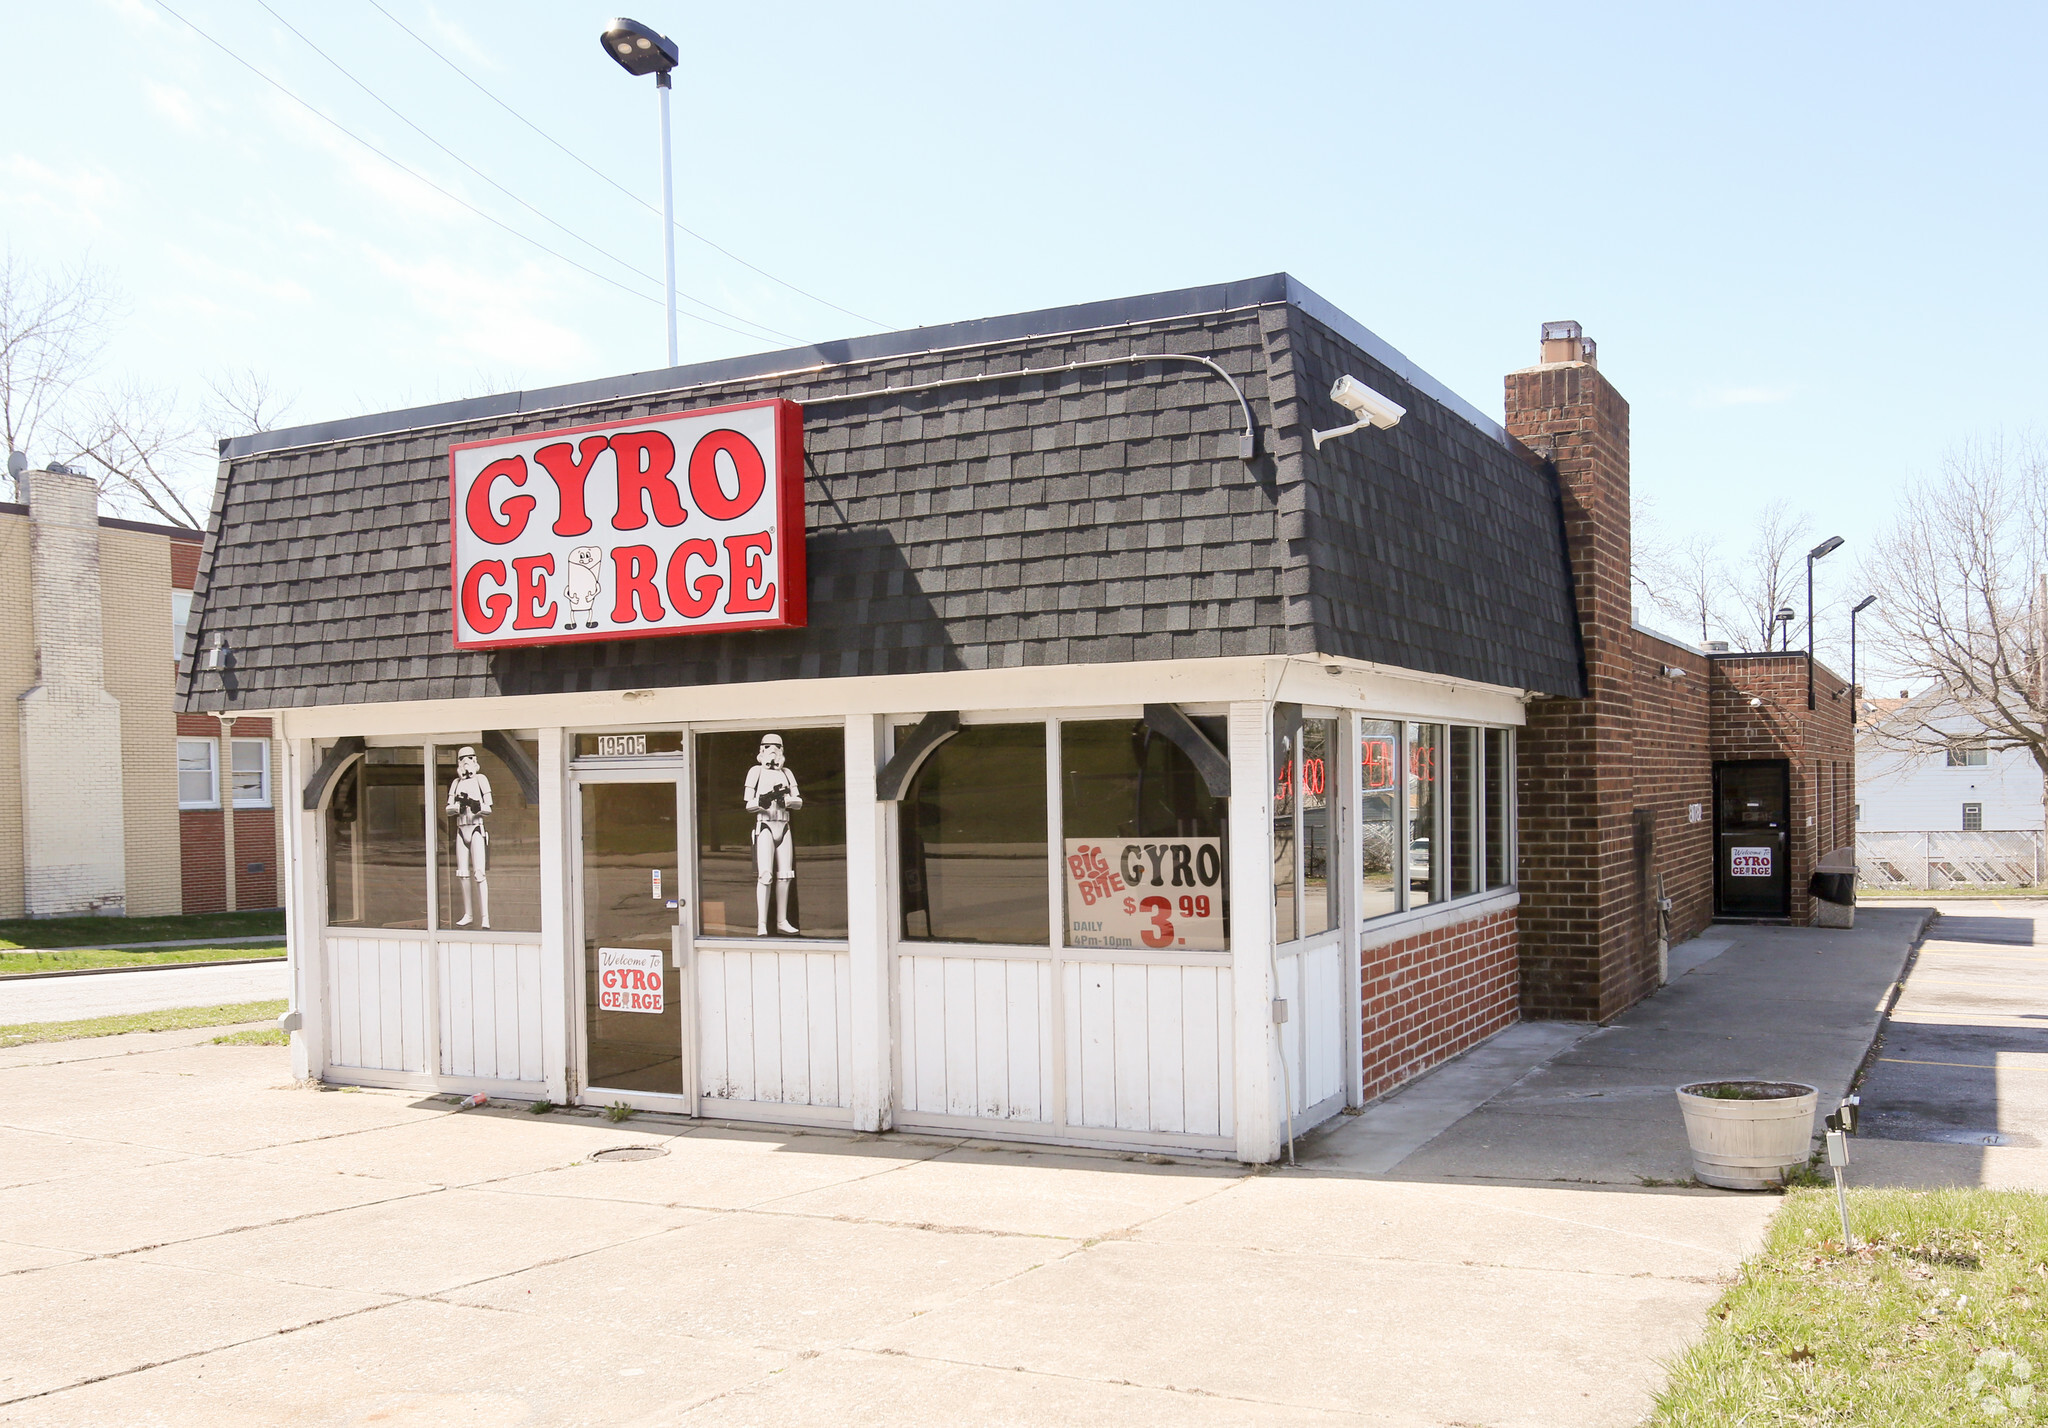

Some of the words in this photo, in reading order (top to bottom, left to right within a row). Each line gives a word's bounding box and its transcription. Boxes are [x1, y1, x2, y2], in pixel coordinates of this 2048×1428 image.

[466, 428, 767, 545] GYRO
[461, 530, 776, 634] GERGE
[599, 735, 645, 755] 19505
[1120, 843, 1220, 887] GYRO
[1733, 856, 1770, 866] GYRO
[1732, 867, 1770, 875] GERGE
[1073, 921, 1103, 932] DAILY
[601, 952, 647, 966] Welcome
[650, 954, 661, 968] To
[602, 969, 662, 990] GYRO
[601, 991, 662, 1010] GERGE
